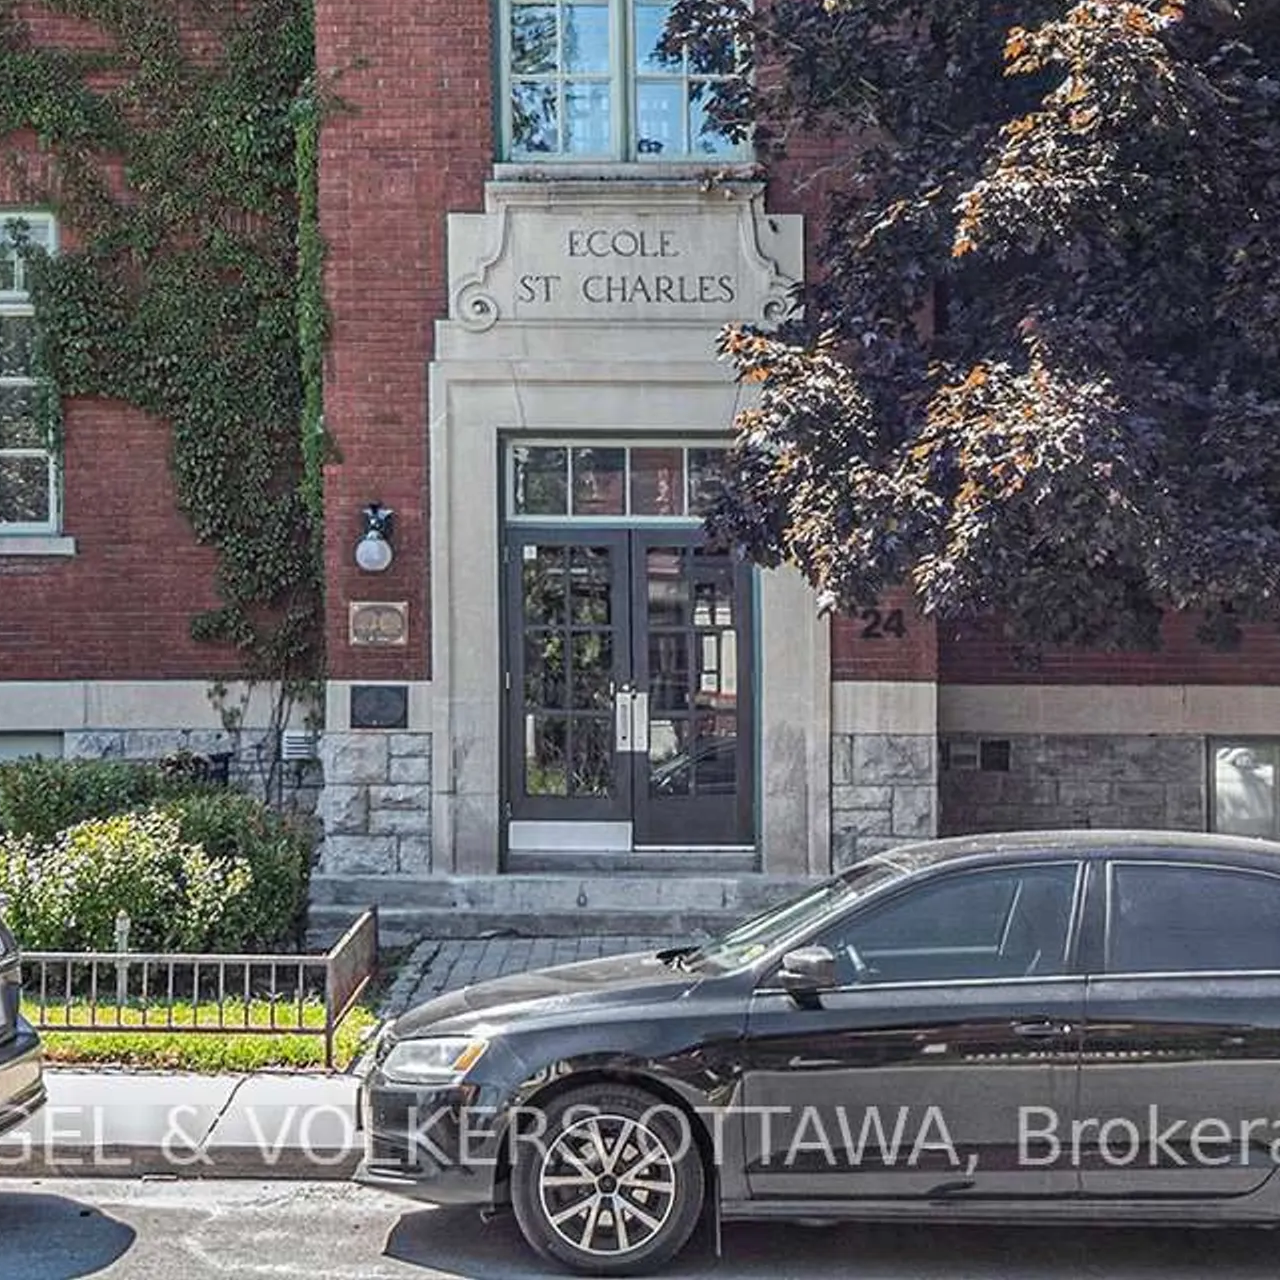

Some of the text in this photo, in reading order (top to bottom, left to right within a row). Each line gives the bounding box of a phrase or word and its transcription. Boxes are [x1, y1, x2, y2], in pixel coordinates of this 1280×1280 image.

[568, 230, 679, 257] ECOLE
[520, 275, 735, 303] ST CHARLES
